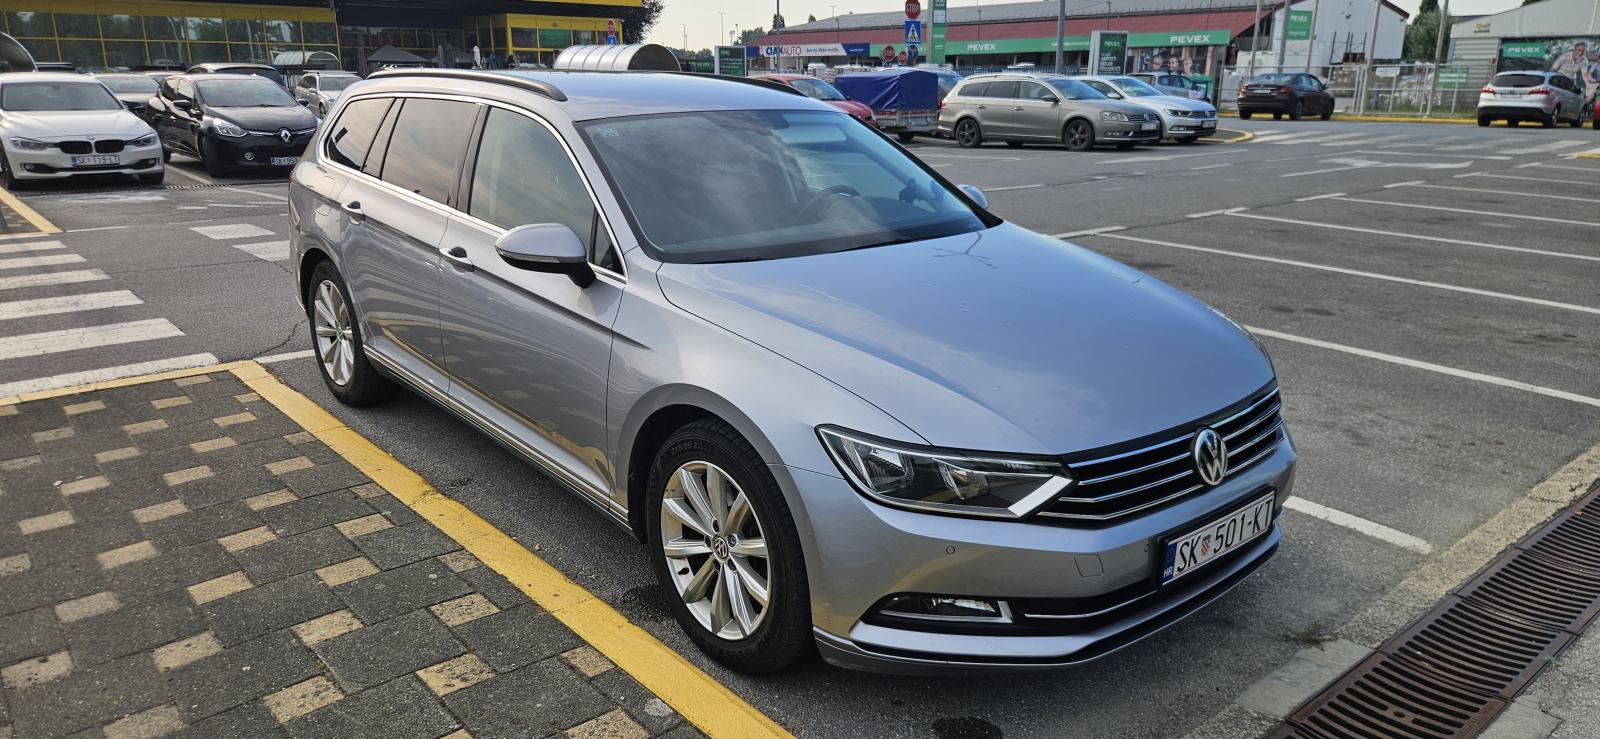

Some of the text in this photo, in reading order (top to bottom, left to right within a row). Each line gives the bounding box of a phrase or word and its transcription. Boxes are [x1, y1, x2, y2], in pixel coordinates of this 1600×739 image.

[905, 4, 920, 13] STOP
[1170, 34, 1211, 44] PEVEX
[967, 43, 996, 51] PEVEX
[1507, 46, 1540, 54] PEVEX
[1176, 499, 1273, 573] SK 501-KT
[1163, 566, 1174, 578] HR
